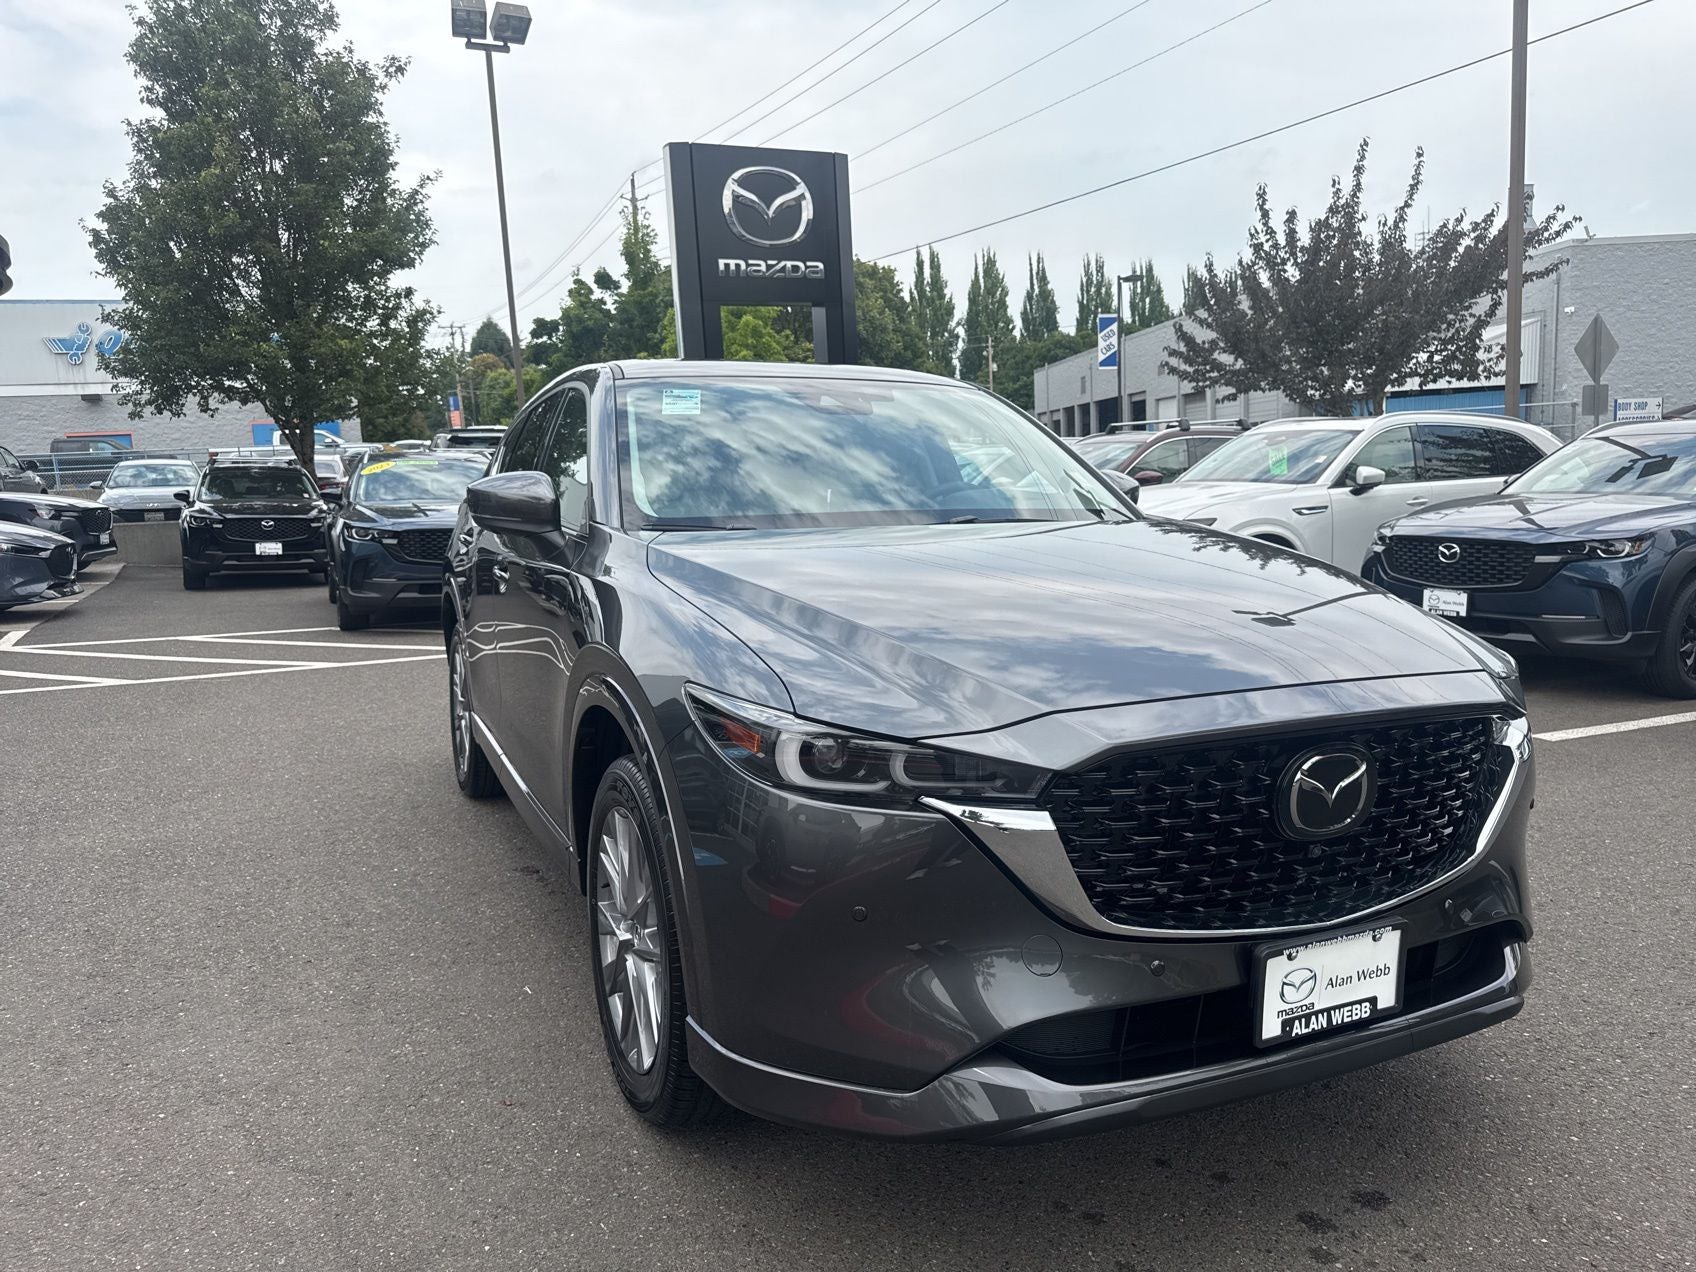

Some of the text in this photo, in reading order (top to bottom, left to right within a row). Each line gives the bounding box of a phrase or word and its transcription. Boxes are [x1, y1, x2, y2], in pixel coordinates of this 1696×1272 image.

[1100, 329, 1116, 342] USED
[1100, 342, 1116, 355] CARS
[1617, 401, 1648, 411] BODY SHOP
[1325, 963, 1391, 990] Alan Webb
[1291, 1001, 1371, 1037] ALAN WEBB
